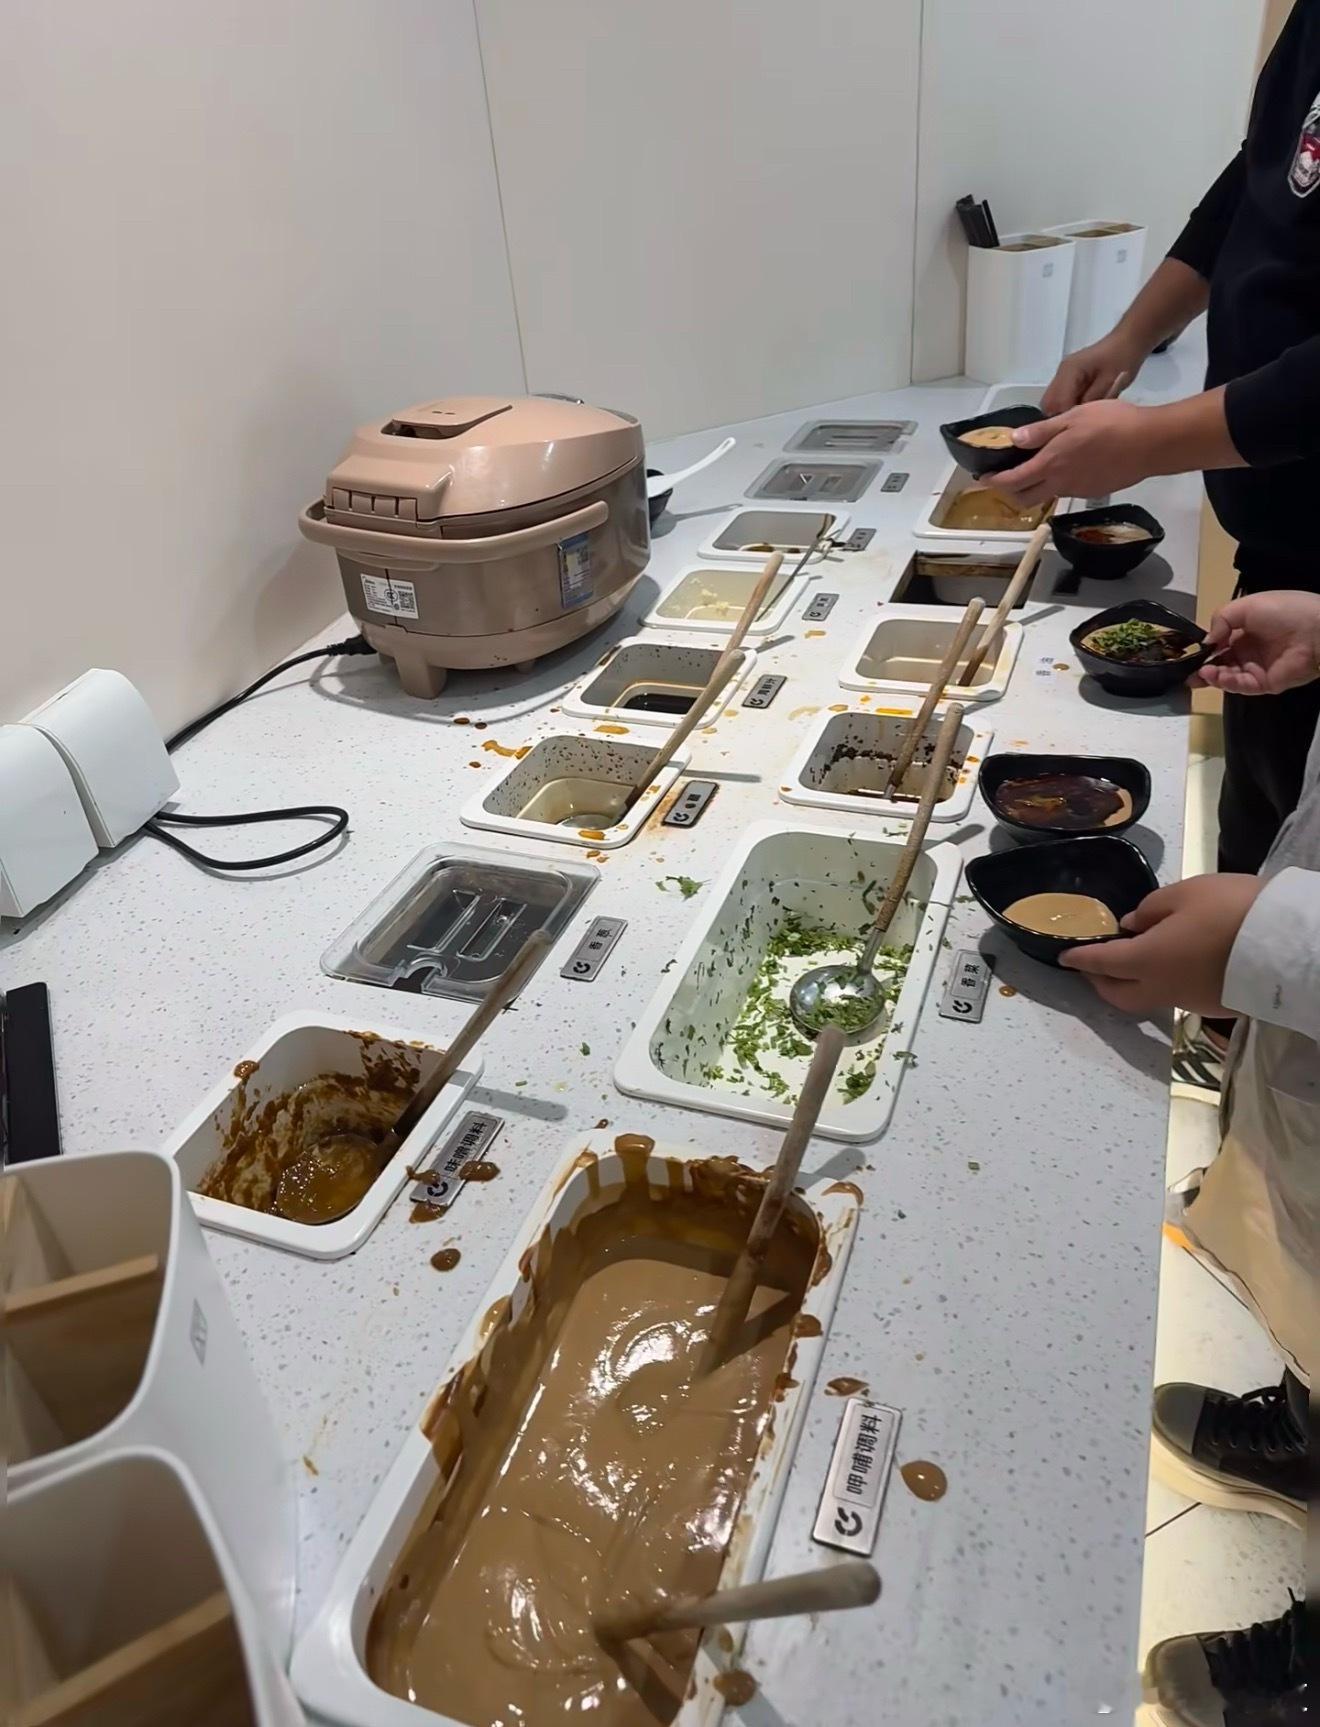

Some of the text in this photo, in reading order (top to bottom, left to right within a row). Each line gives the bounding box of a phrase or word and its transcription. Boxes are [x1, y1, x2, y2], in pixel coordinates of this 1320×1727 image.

[444, 1121, 487, 1172] 味噌调料
[846, 1414, 882, 1496] 呷哺调料
